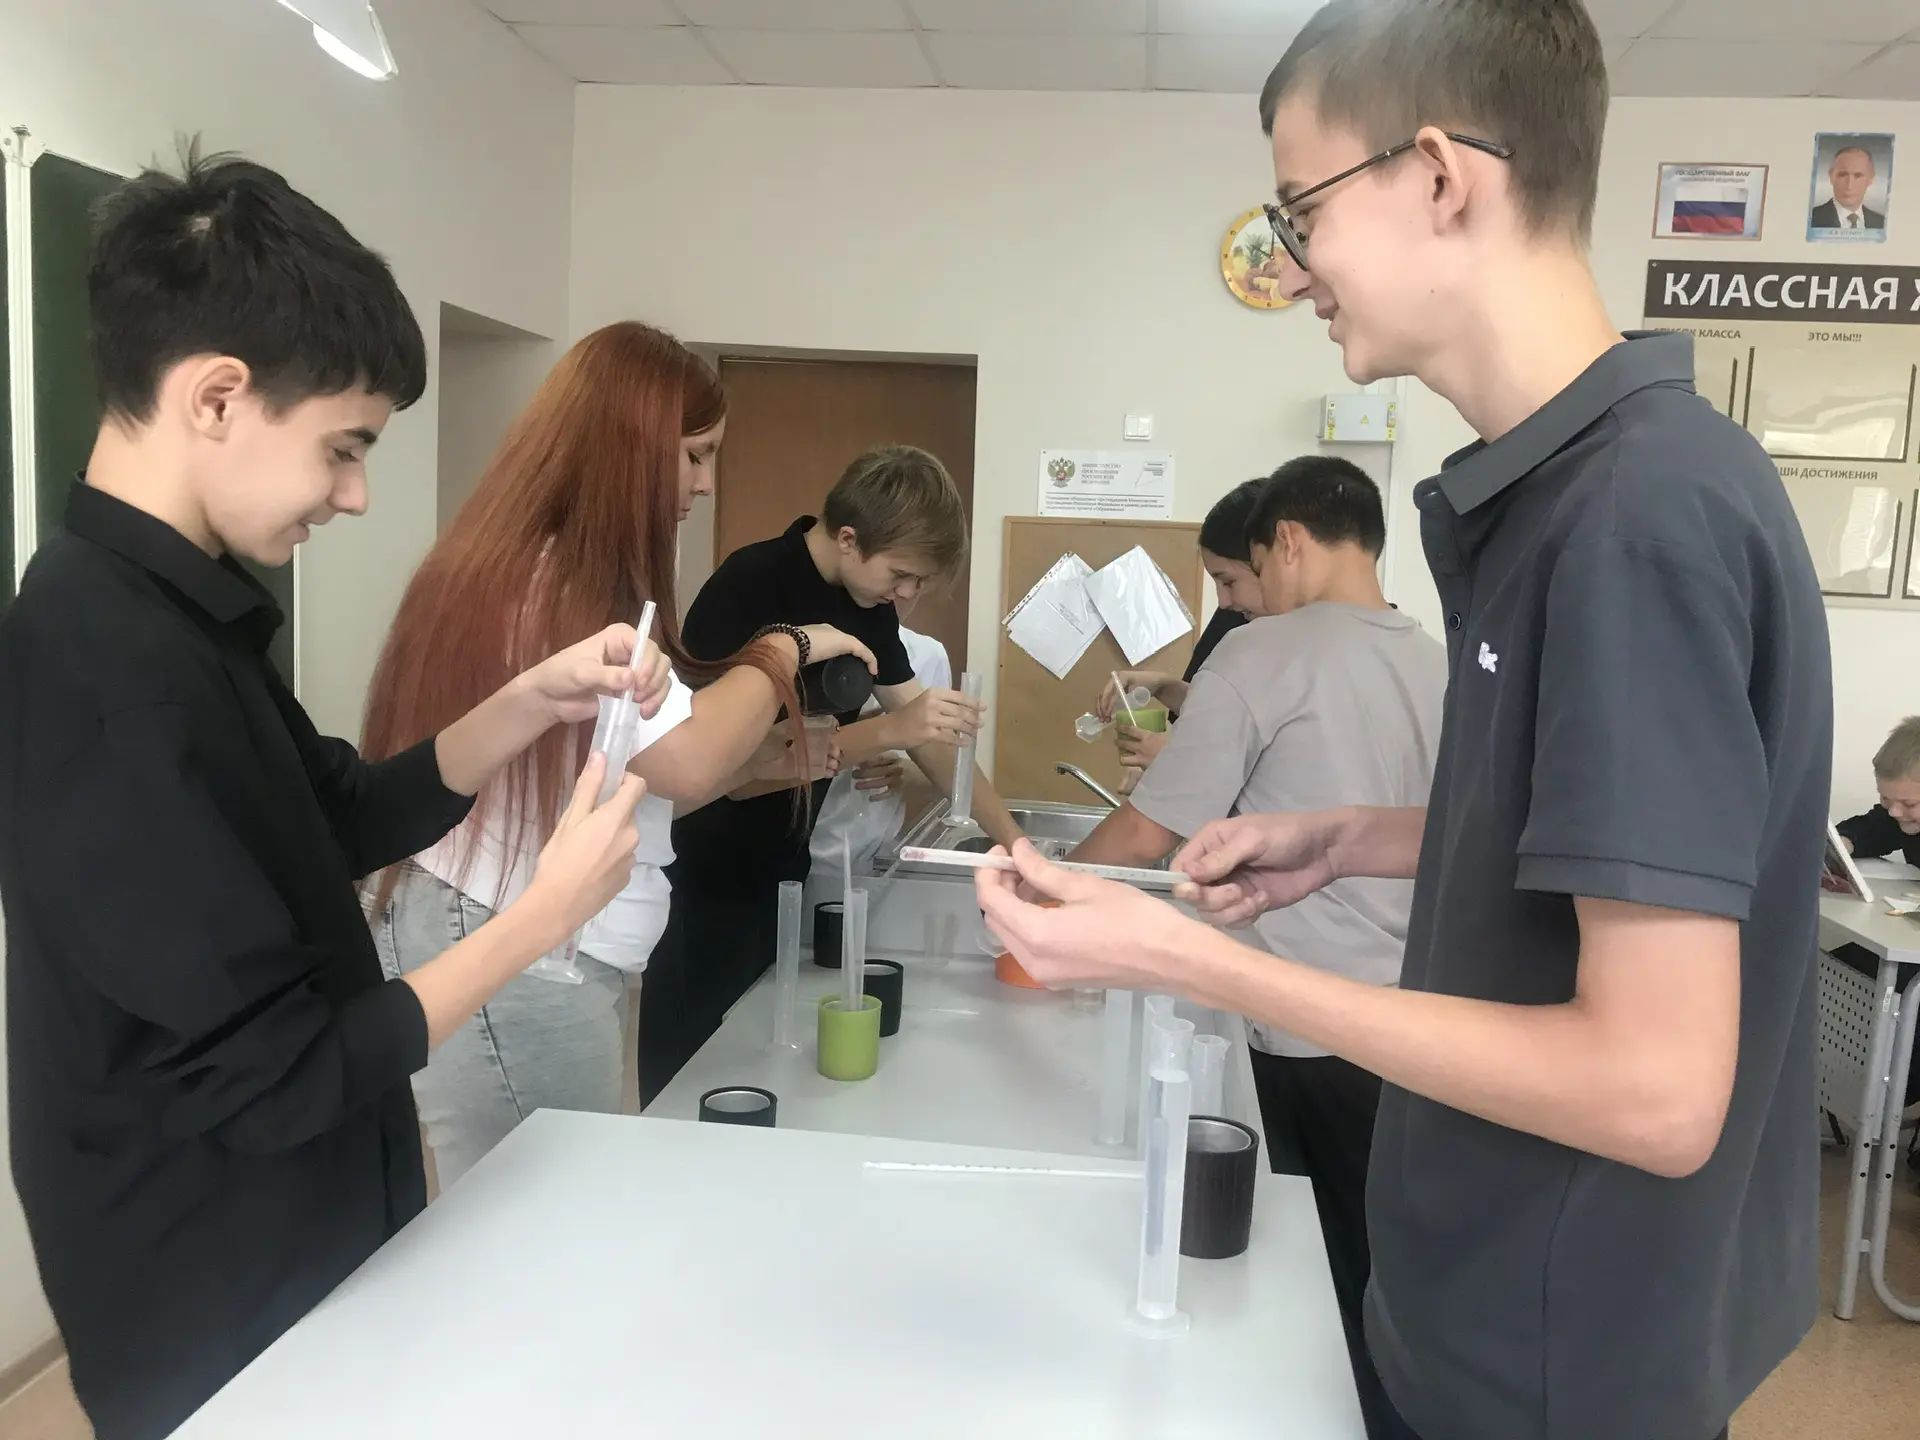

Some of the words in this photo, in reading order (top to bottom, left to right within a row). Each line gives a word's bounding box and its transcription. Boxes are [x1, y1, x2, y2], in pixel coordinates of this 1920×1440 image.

[1663, 273, 1899, 310] КЛАССНАЯ
[1698, 328, 1741, 339] КЛАССА
[1808, 331, 1829, 342] ЭТО
[1832, 332, 1862, 342] МЫ!!!
[1779, 466, 1798, 477] ШИ
[1800, 467, 1878, 480] ДОСТИЖЕНИЯ
